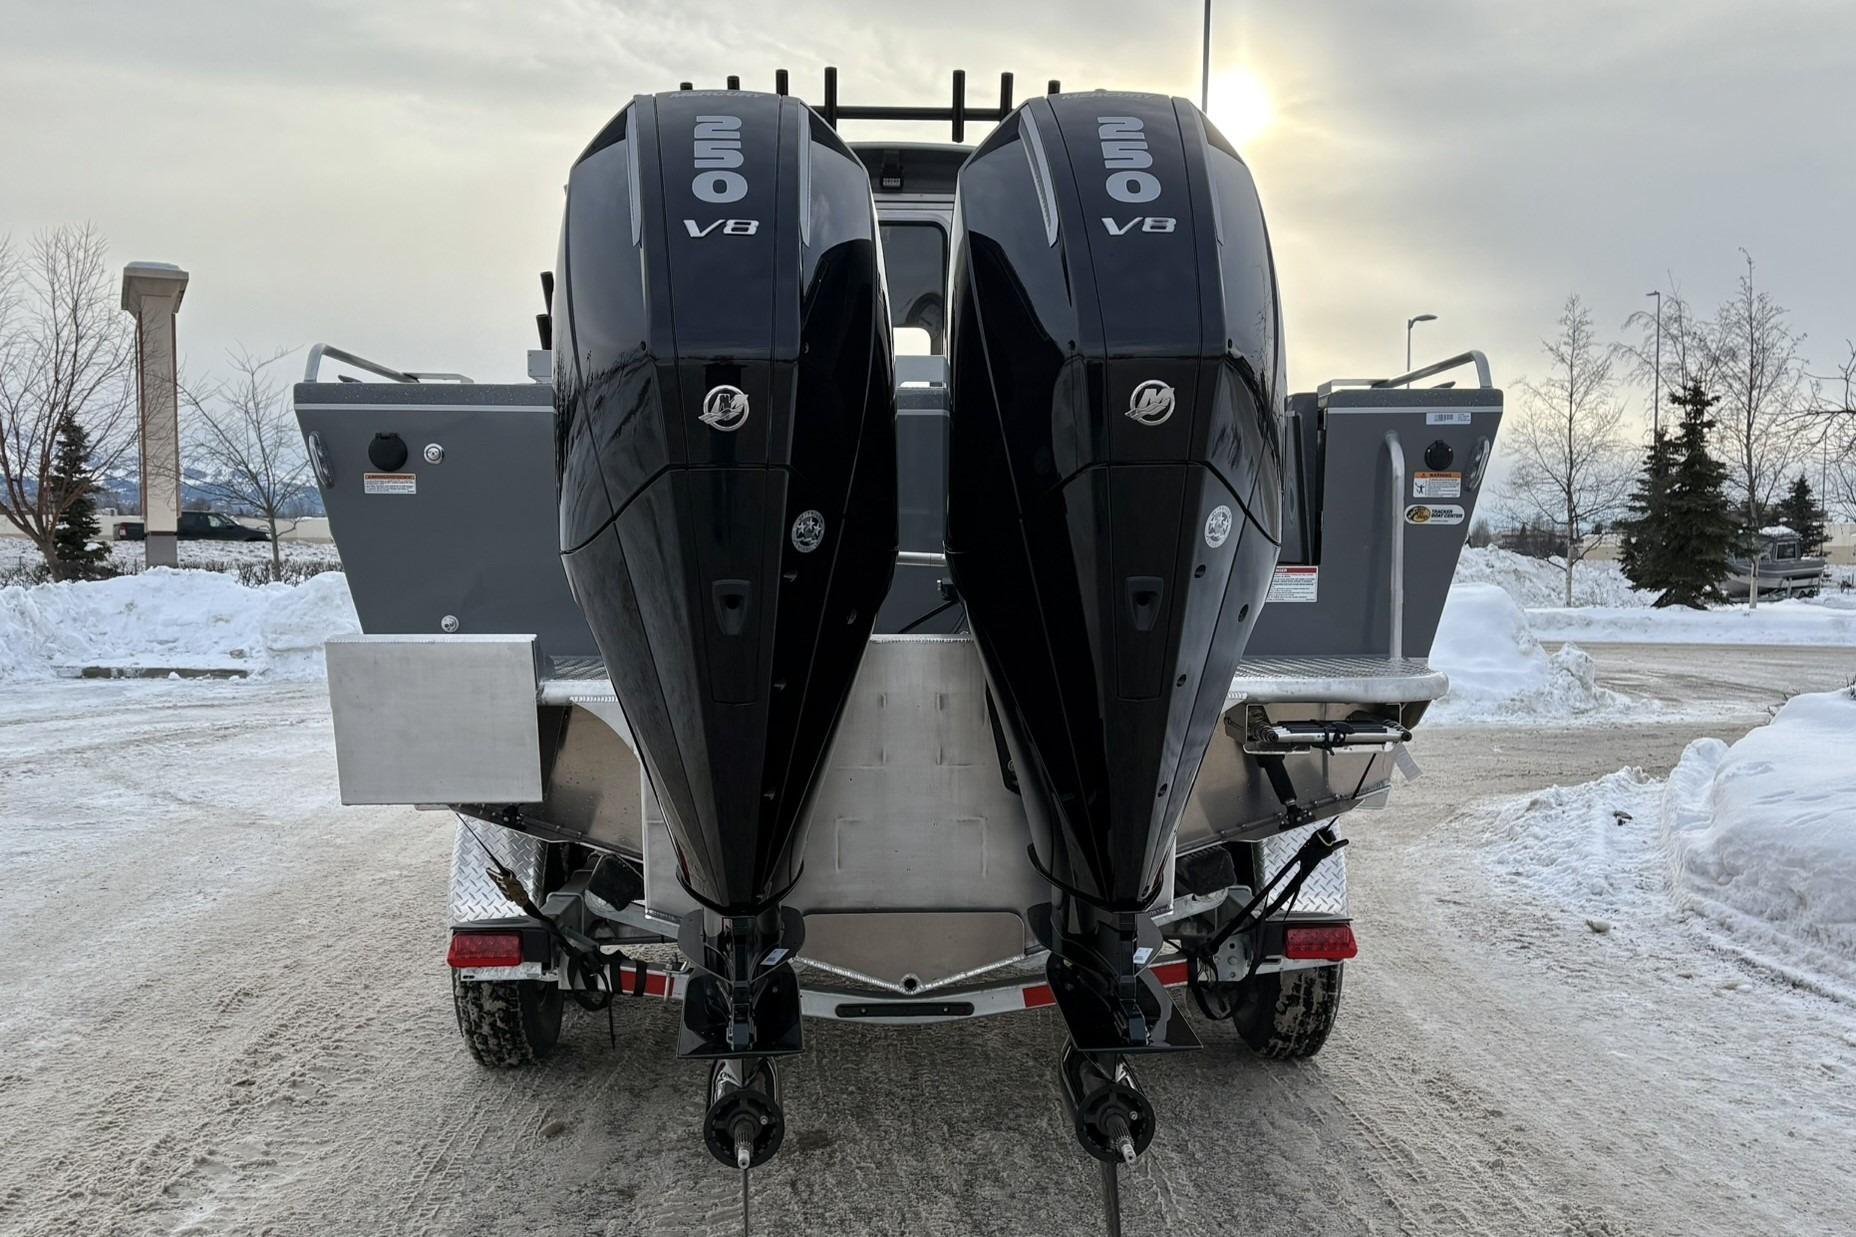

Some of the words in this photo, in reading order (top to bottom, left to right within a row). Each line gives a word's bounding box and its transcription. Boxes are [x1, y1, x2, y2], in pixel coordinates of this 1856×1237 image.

[692, 115, 748, 203] 250
[1097, 116, 1161, 203] 250
[683, 219, 759, 237] V8
[1101, 217, 1176, 235] V8
